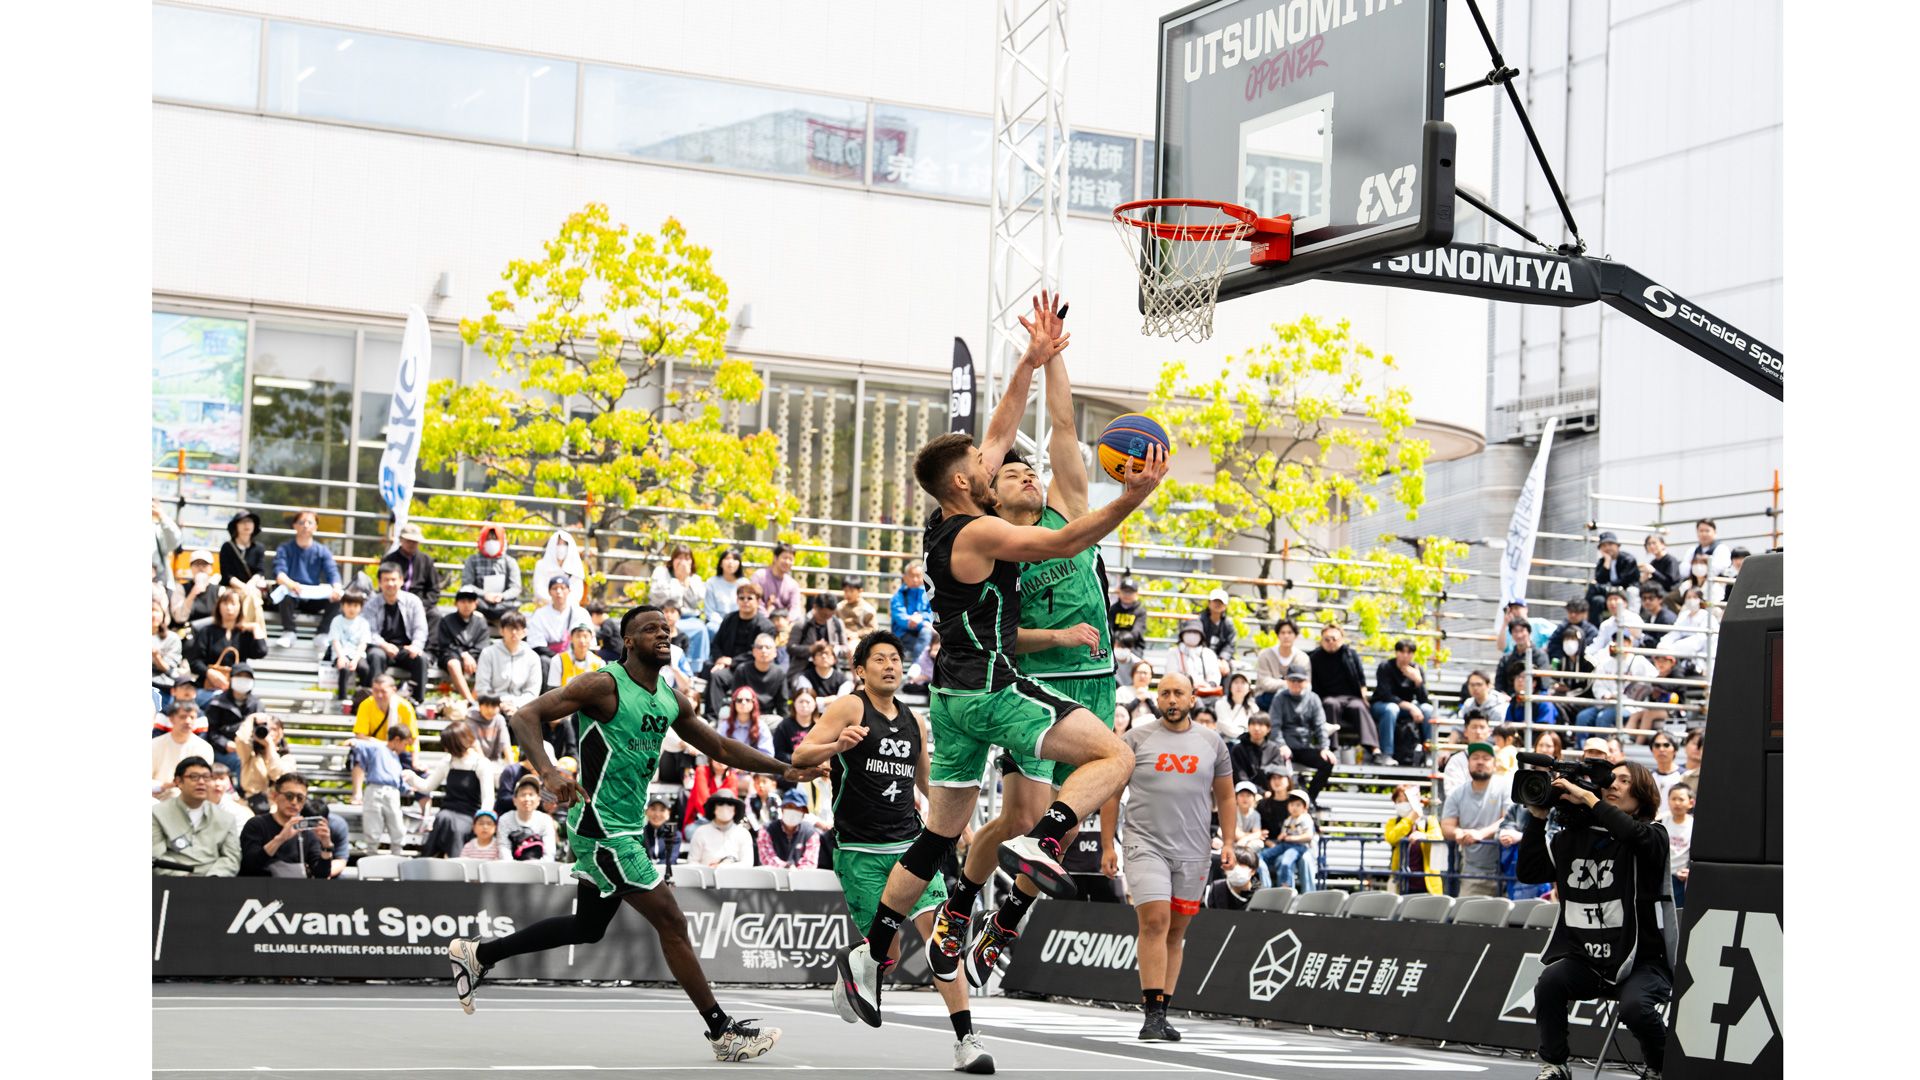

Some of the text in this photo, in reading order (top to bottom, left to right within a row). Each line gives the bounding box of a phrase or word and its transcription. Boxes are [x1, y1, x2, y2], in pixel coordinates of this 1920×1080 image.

[1184, 0, 1404, 83] UTSUNOMI
[1244, 33, 1329, 101] OPENER
[1372, 247, 1574, 293] SUNOMIYA
[1678, 303, 1747, 351] Schelde
[388, 355, 418, 466] TKC
[1020, 559, 1079, 599] INAGAWA
[1041, 587, 1055, 616] 1
[881, 780, 902, 803] 4
[1079, 840, 1099, 853] 042
[226, 898, 516, 944] Avant Sports
[1583, 906, 1604, 926] TV
[254, 943, 450, 955] RELIABLE PARTNER FOR SEATING SO
[741, 949, 837, 970] 新潟トランシ
[1583, 942, 1611, 958] 029
[1294, 951, 1428, 998] 関東自動車
